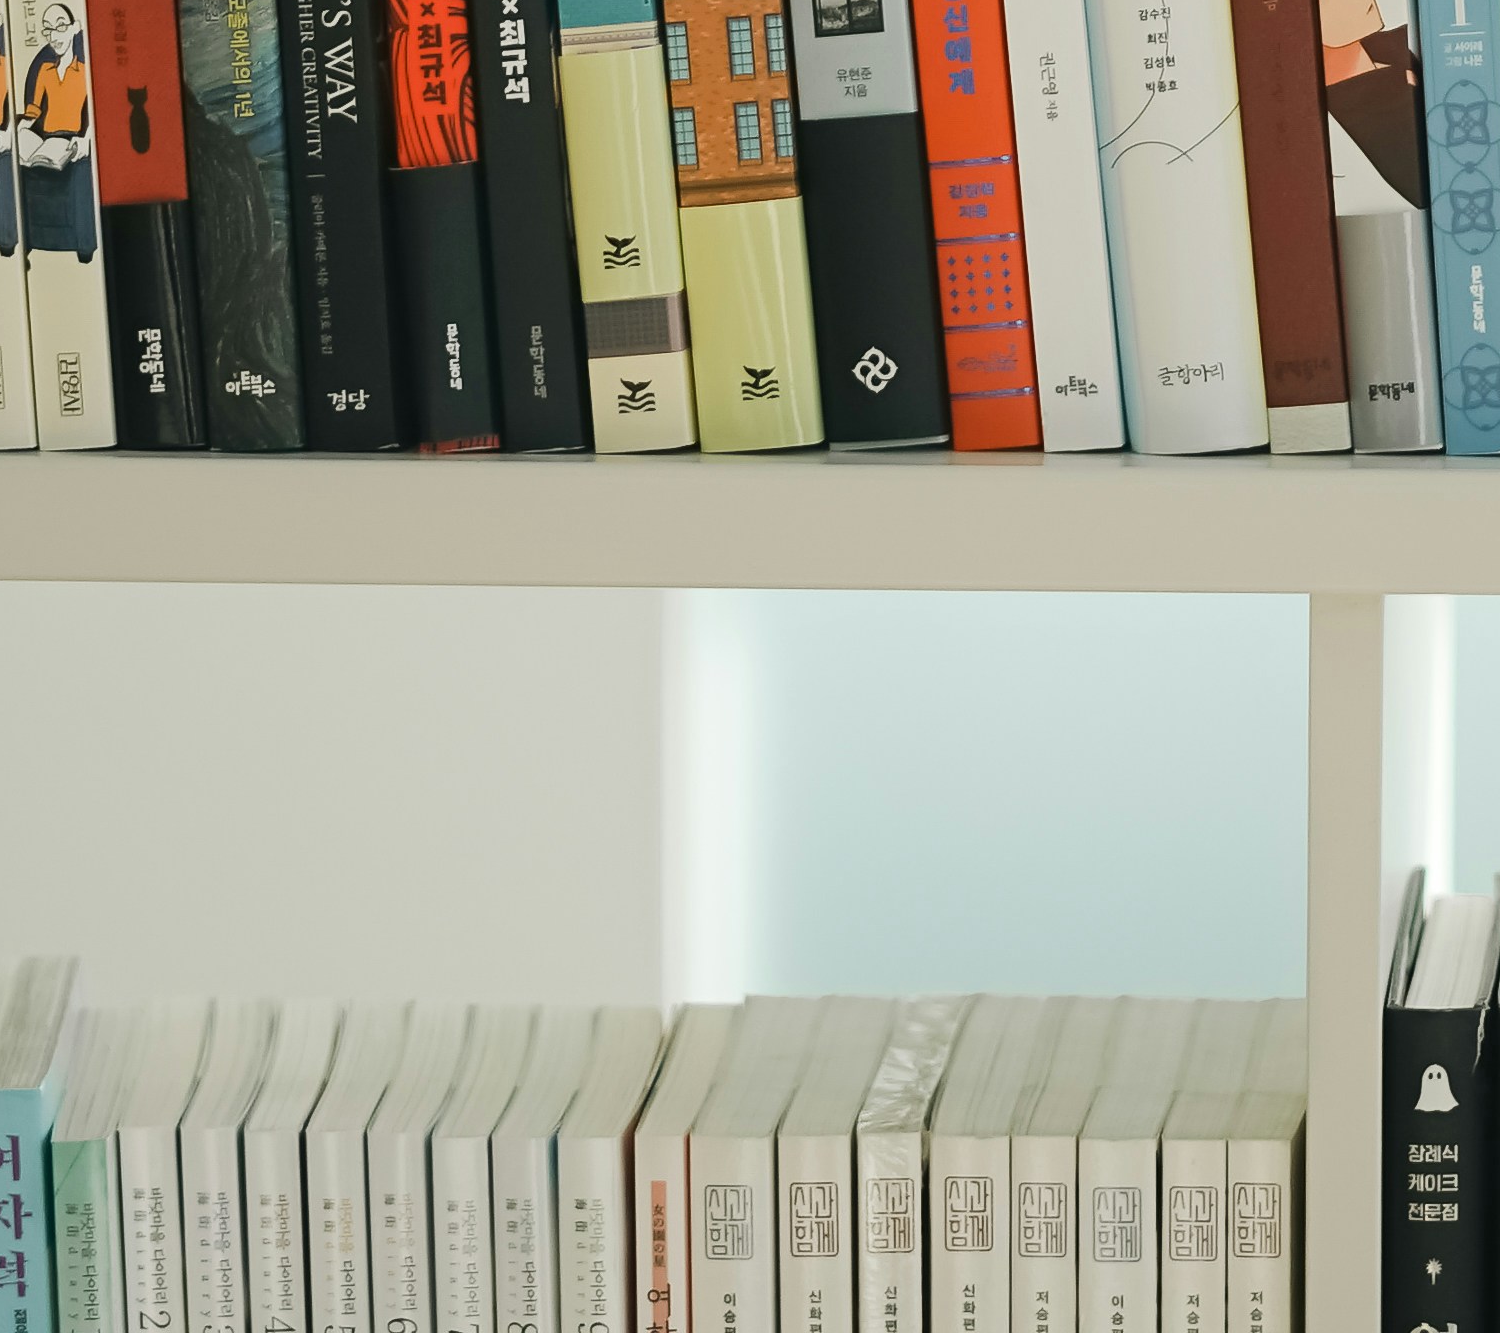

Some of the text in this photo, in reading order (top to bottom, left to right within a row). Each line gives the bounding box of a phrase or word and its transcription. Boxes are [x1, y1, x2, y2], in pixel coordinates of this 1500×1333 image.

[322, 37, 359, 125] WAY
[415, 24, 448, 106] 최규석
[300, 46, 324, 160] CREATIVITY
[1407, 1144, 1459, 1163] 장례식
[1407, 1173, 1459, 1192] 케이크
[1407, 1202, 1459, 1222] 전문점
[148, 1187, 168, 1305] 바닷마을 다이어리
[140, 1310, 171, 1331] 2
[962, 1284, 976, 1330] 신화편
